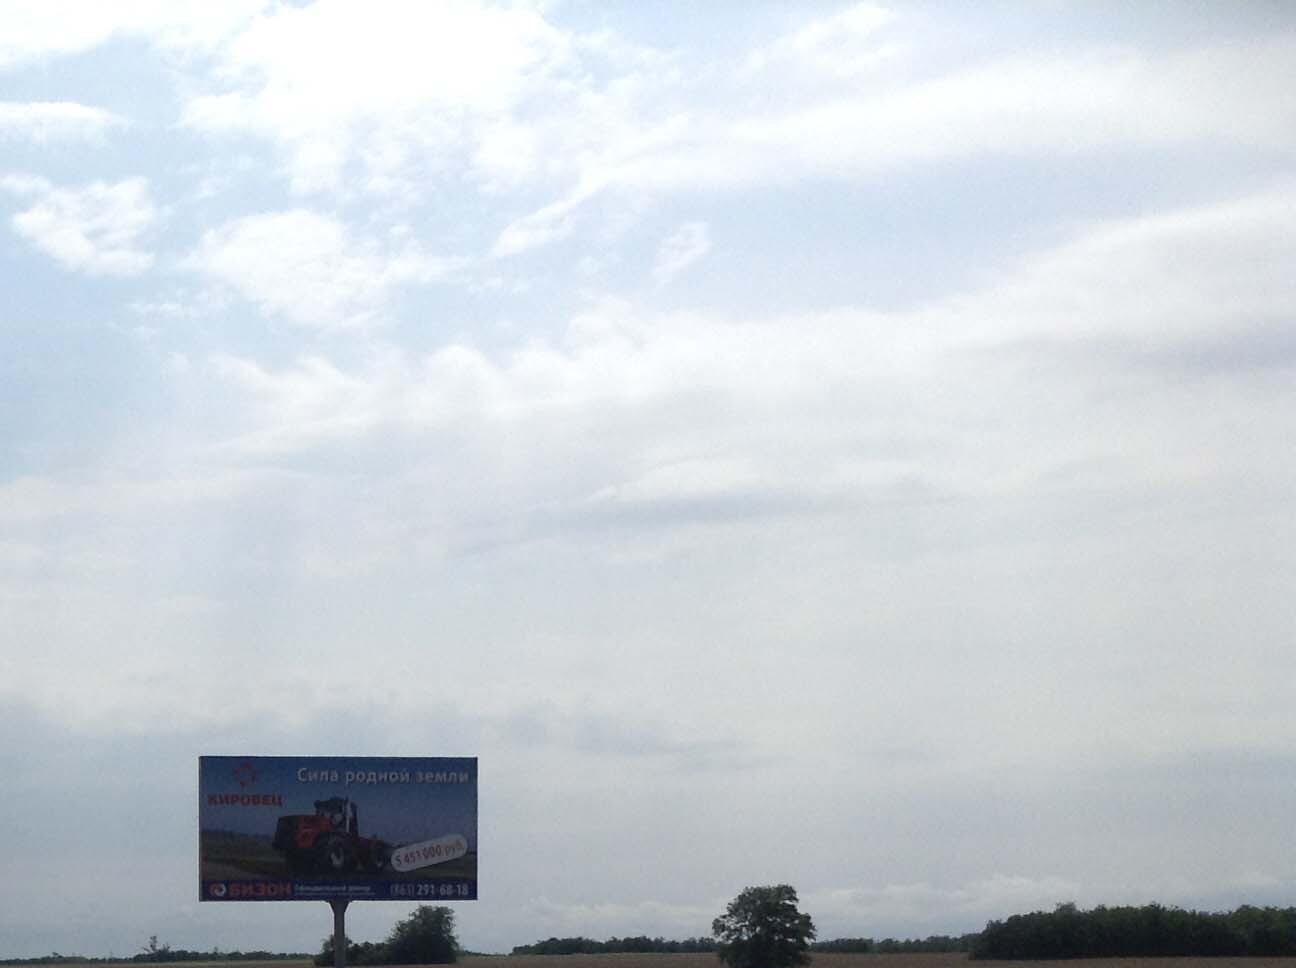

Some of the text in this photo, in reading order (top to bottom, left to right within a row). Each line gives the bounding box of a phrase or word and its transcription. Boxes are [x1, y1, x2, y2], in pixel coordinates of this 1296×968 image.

[297, 766, 469, 789] Сила родной земли
[207, 793, 284, 808] КИРОВЕЦ
[229, 882, 292, 897] БИЗОН
[416, 883, 469, 897] 291-68-18
